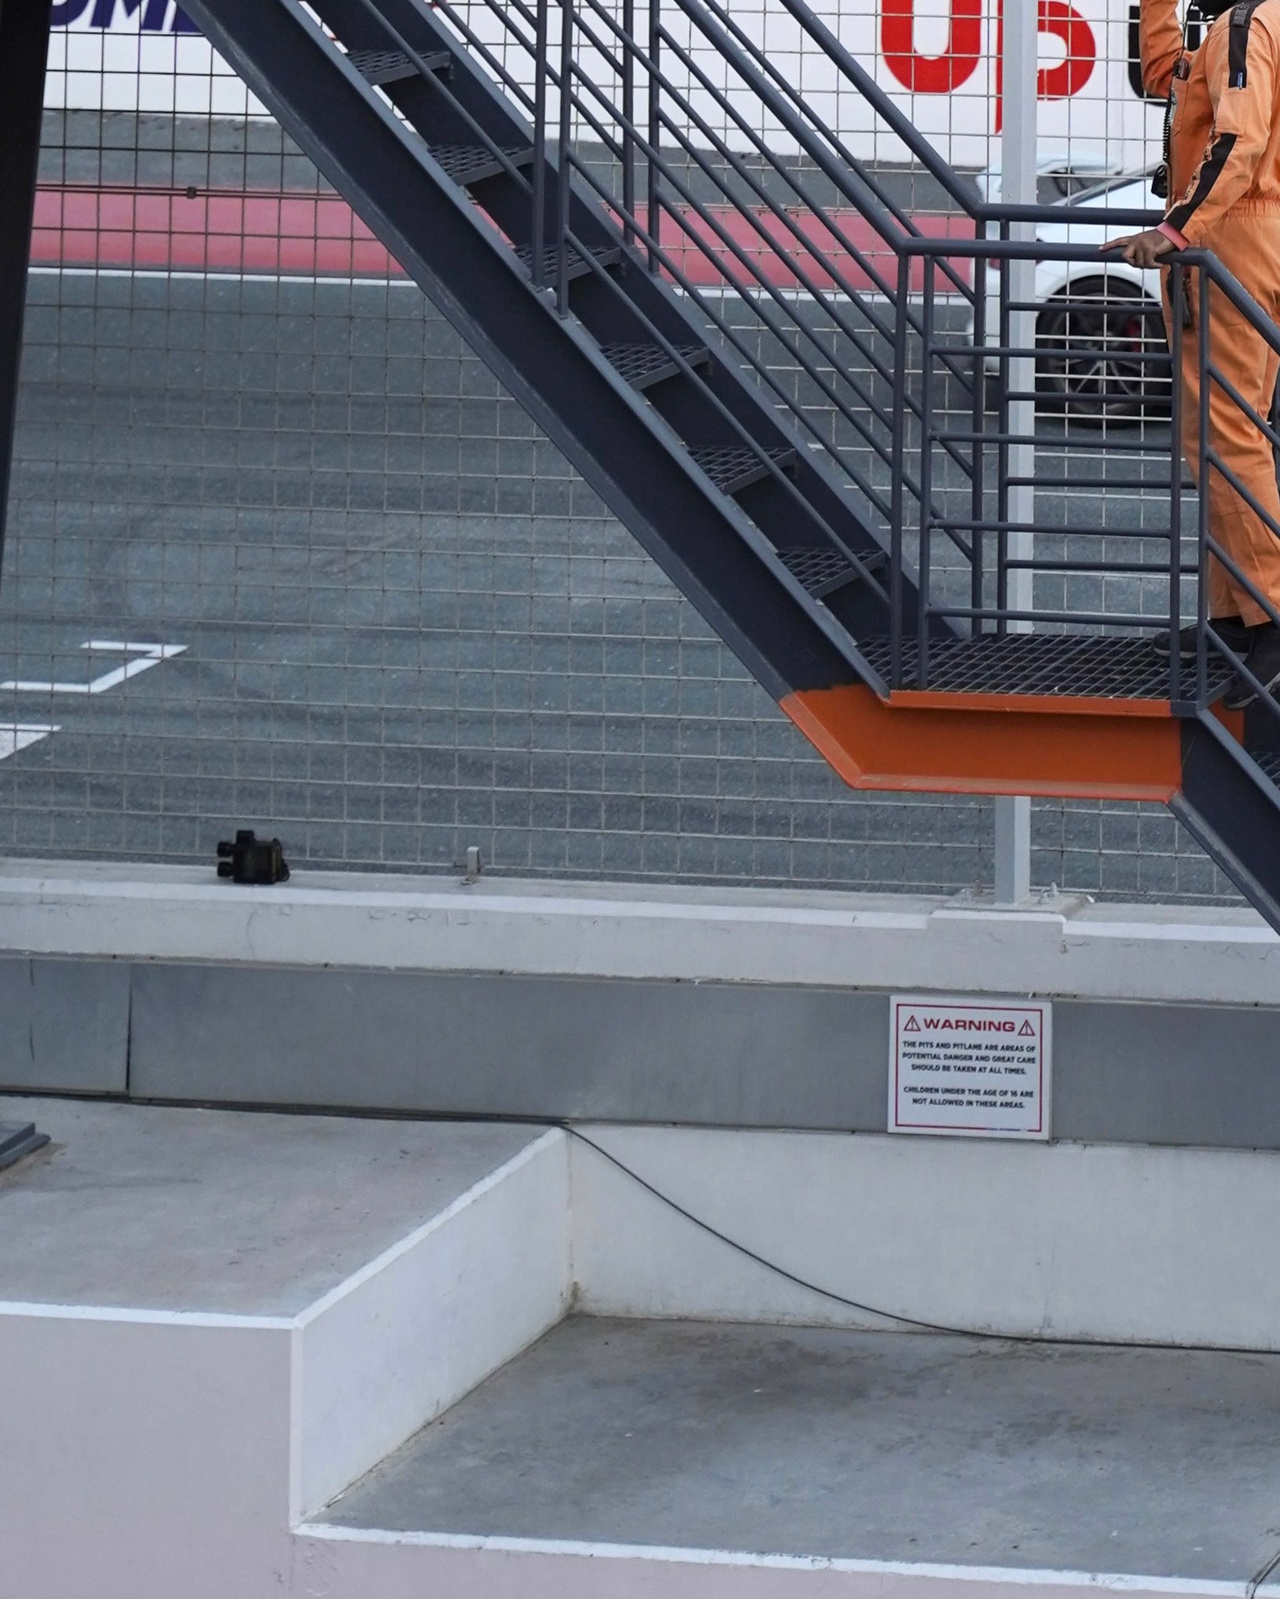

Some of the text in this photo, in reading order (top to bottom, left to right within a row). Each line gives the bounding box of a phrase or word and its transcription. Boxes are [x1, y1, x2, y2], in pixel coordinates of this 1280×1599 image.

[924, 1018, 1015, 1032] WARNING
[903, 1052, 941, 1060] POTENTIAL
[944, 1054, 973, 1062] DANGER
[1017, 1056, 1036, 1064] CARE
[1004, 1067, 1026, 1075] TIMES.
[904, 1086, 939, 1094] CHILDREN
[941, 1087, 966, 1095] UNDER
[968, 1088, 981, 1096] THE
[1020, 1090, 1034, 1098] ARE
[929, 1099, 964, 1107] ALLOWED
[976, 1100, 997, 1108] THESE
[999, 1101, 1025, 1109] AREAS.
